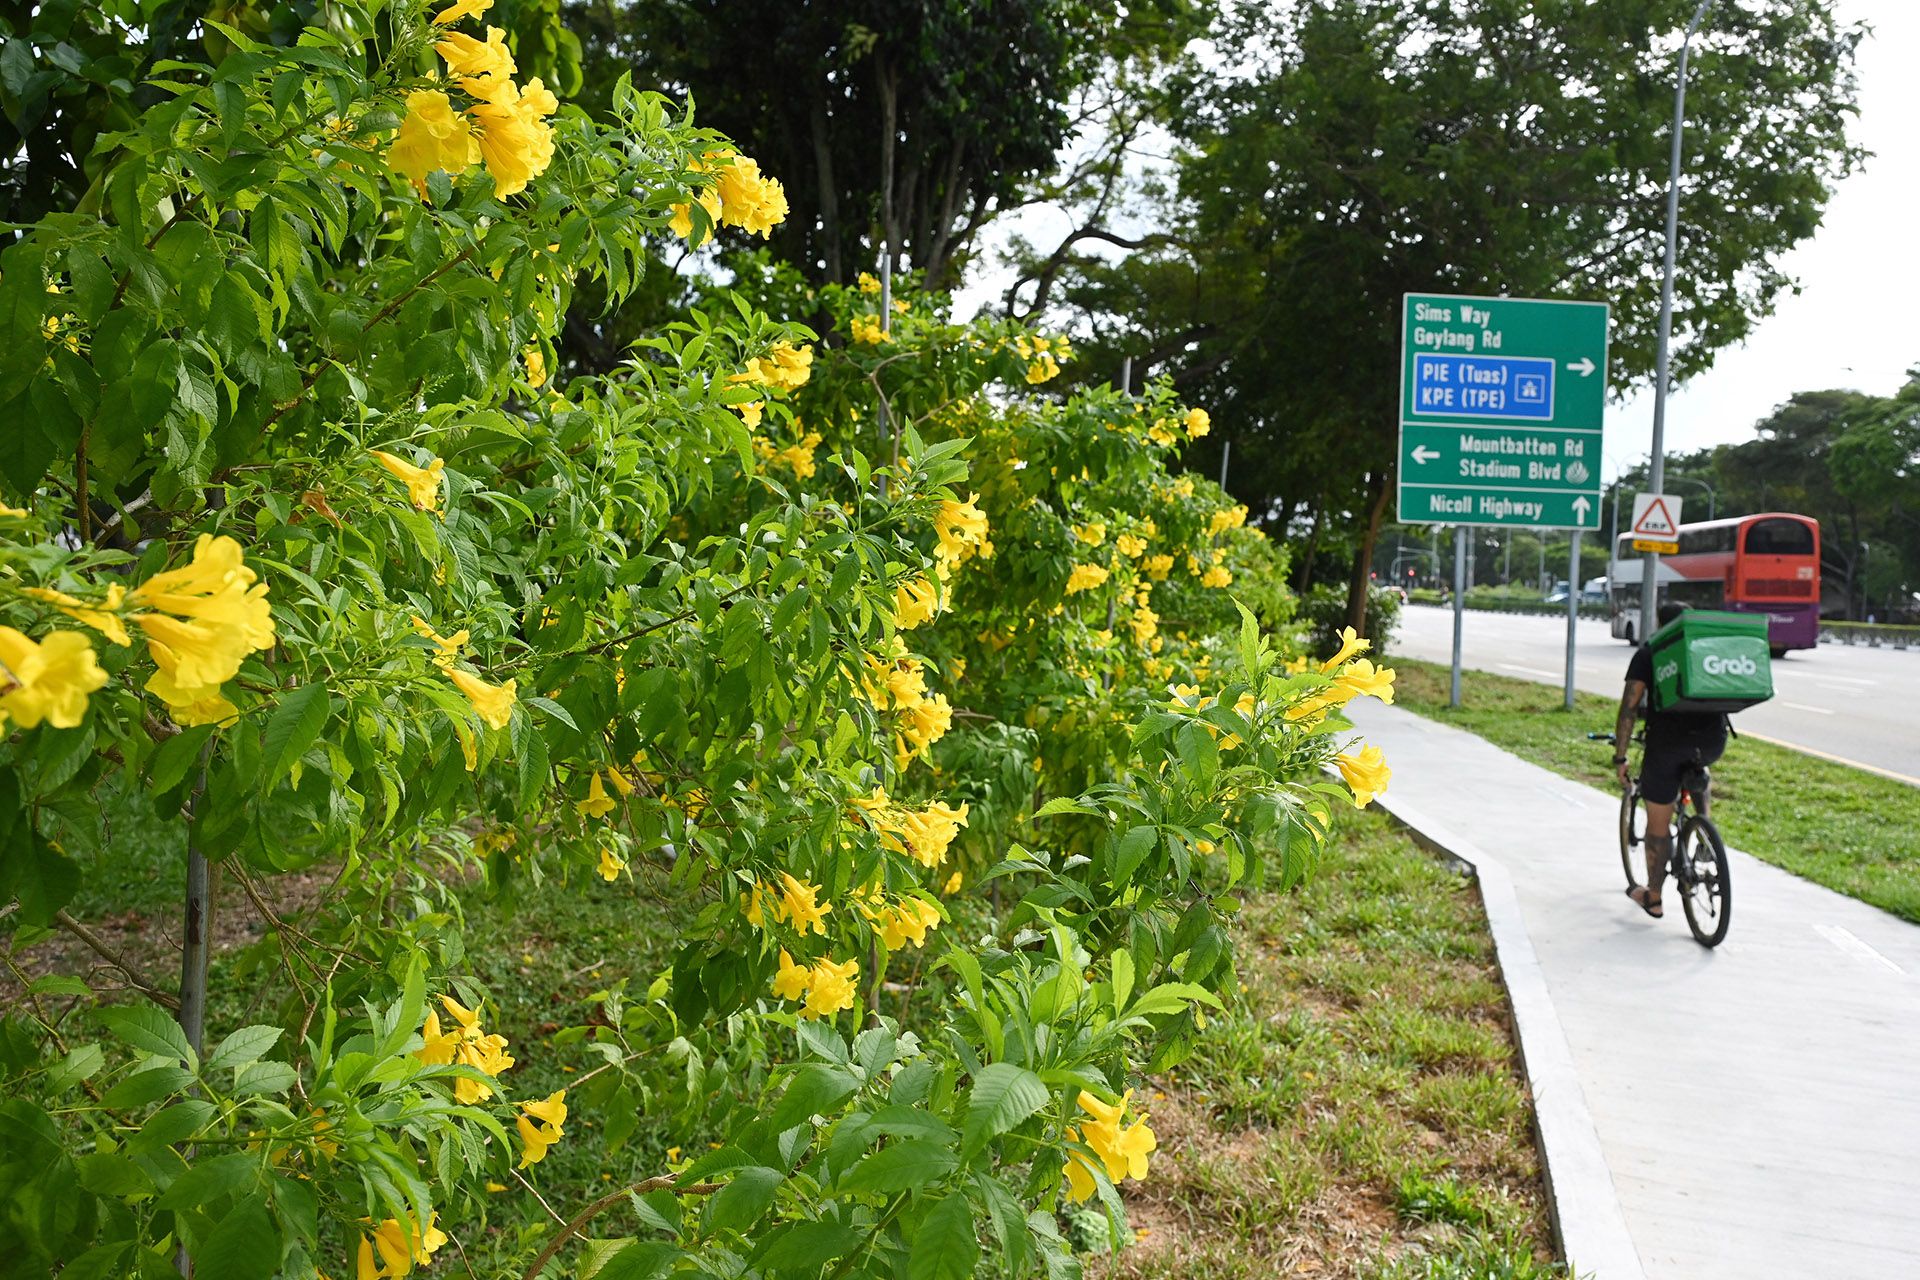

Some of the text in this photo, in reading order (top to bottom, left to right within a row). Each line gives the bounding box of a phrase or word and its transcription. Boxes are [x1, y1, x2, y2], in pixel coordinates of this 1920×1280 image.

[1414, 302, 1491, 328] Sims Way
[1413, 327, 1502, 351] Geylang Rd
[1422, 362, 1508, 385] PIE (Tuas)
[1421, 387, 1506, 410] KPE (TPE)
[1459, 434, 1584, 457] Mountbatten Rd
[1459, 459, 1561, 481] Stadium Blvd
[1429, 494, 1543, 521] Nicoll Highway
[1703, 654, 1757, 676] Grab
